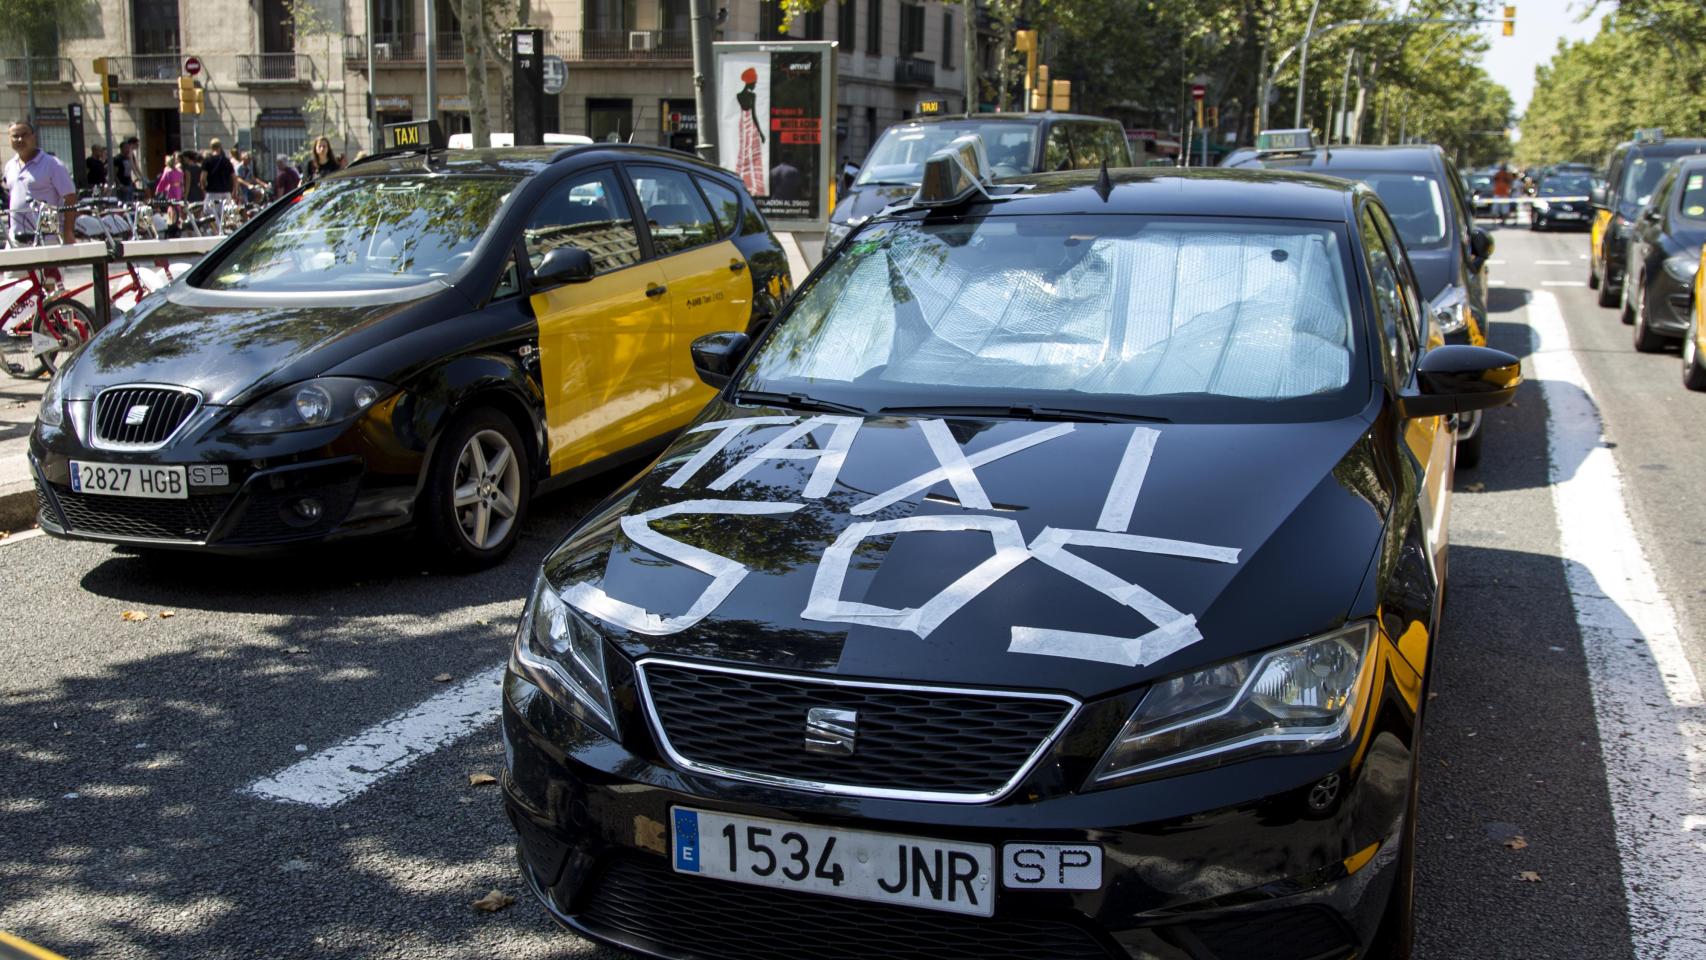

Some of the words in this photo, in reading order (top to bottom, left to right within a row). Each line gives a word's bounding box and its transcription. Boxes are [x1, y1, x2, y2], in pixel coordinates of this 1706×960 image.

[921, 101, 938, 112] TAXI
[394, 126, 419, 145] TAXI
[1271, 134, 1296, 148] TAXI
[83, 466, 132, 492] 2827
[140, 469, 182, 494] HGB
[192, 467, 224, 484] SP
[663, 415, 1162, 532] TAXI
[560, 498, 1242, 667] SOS
[682, 846, 693, 861] E
[722, 822, 845, 887] 1534
[877, 844, 980, 907] JNR
[1012, 848, 1092, 884] SP
